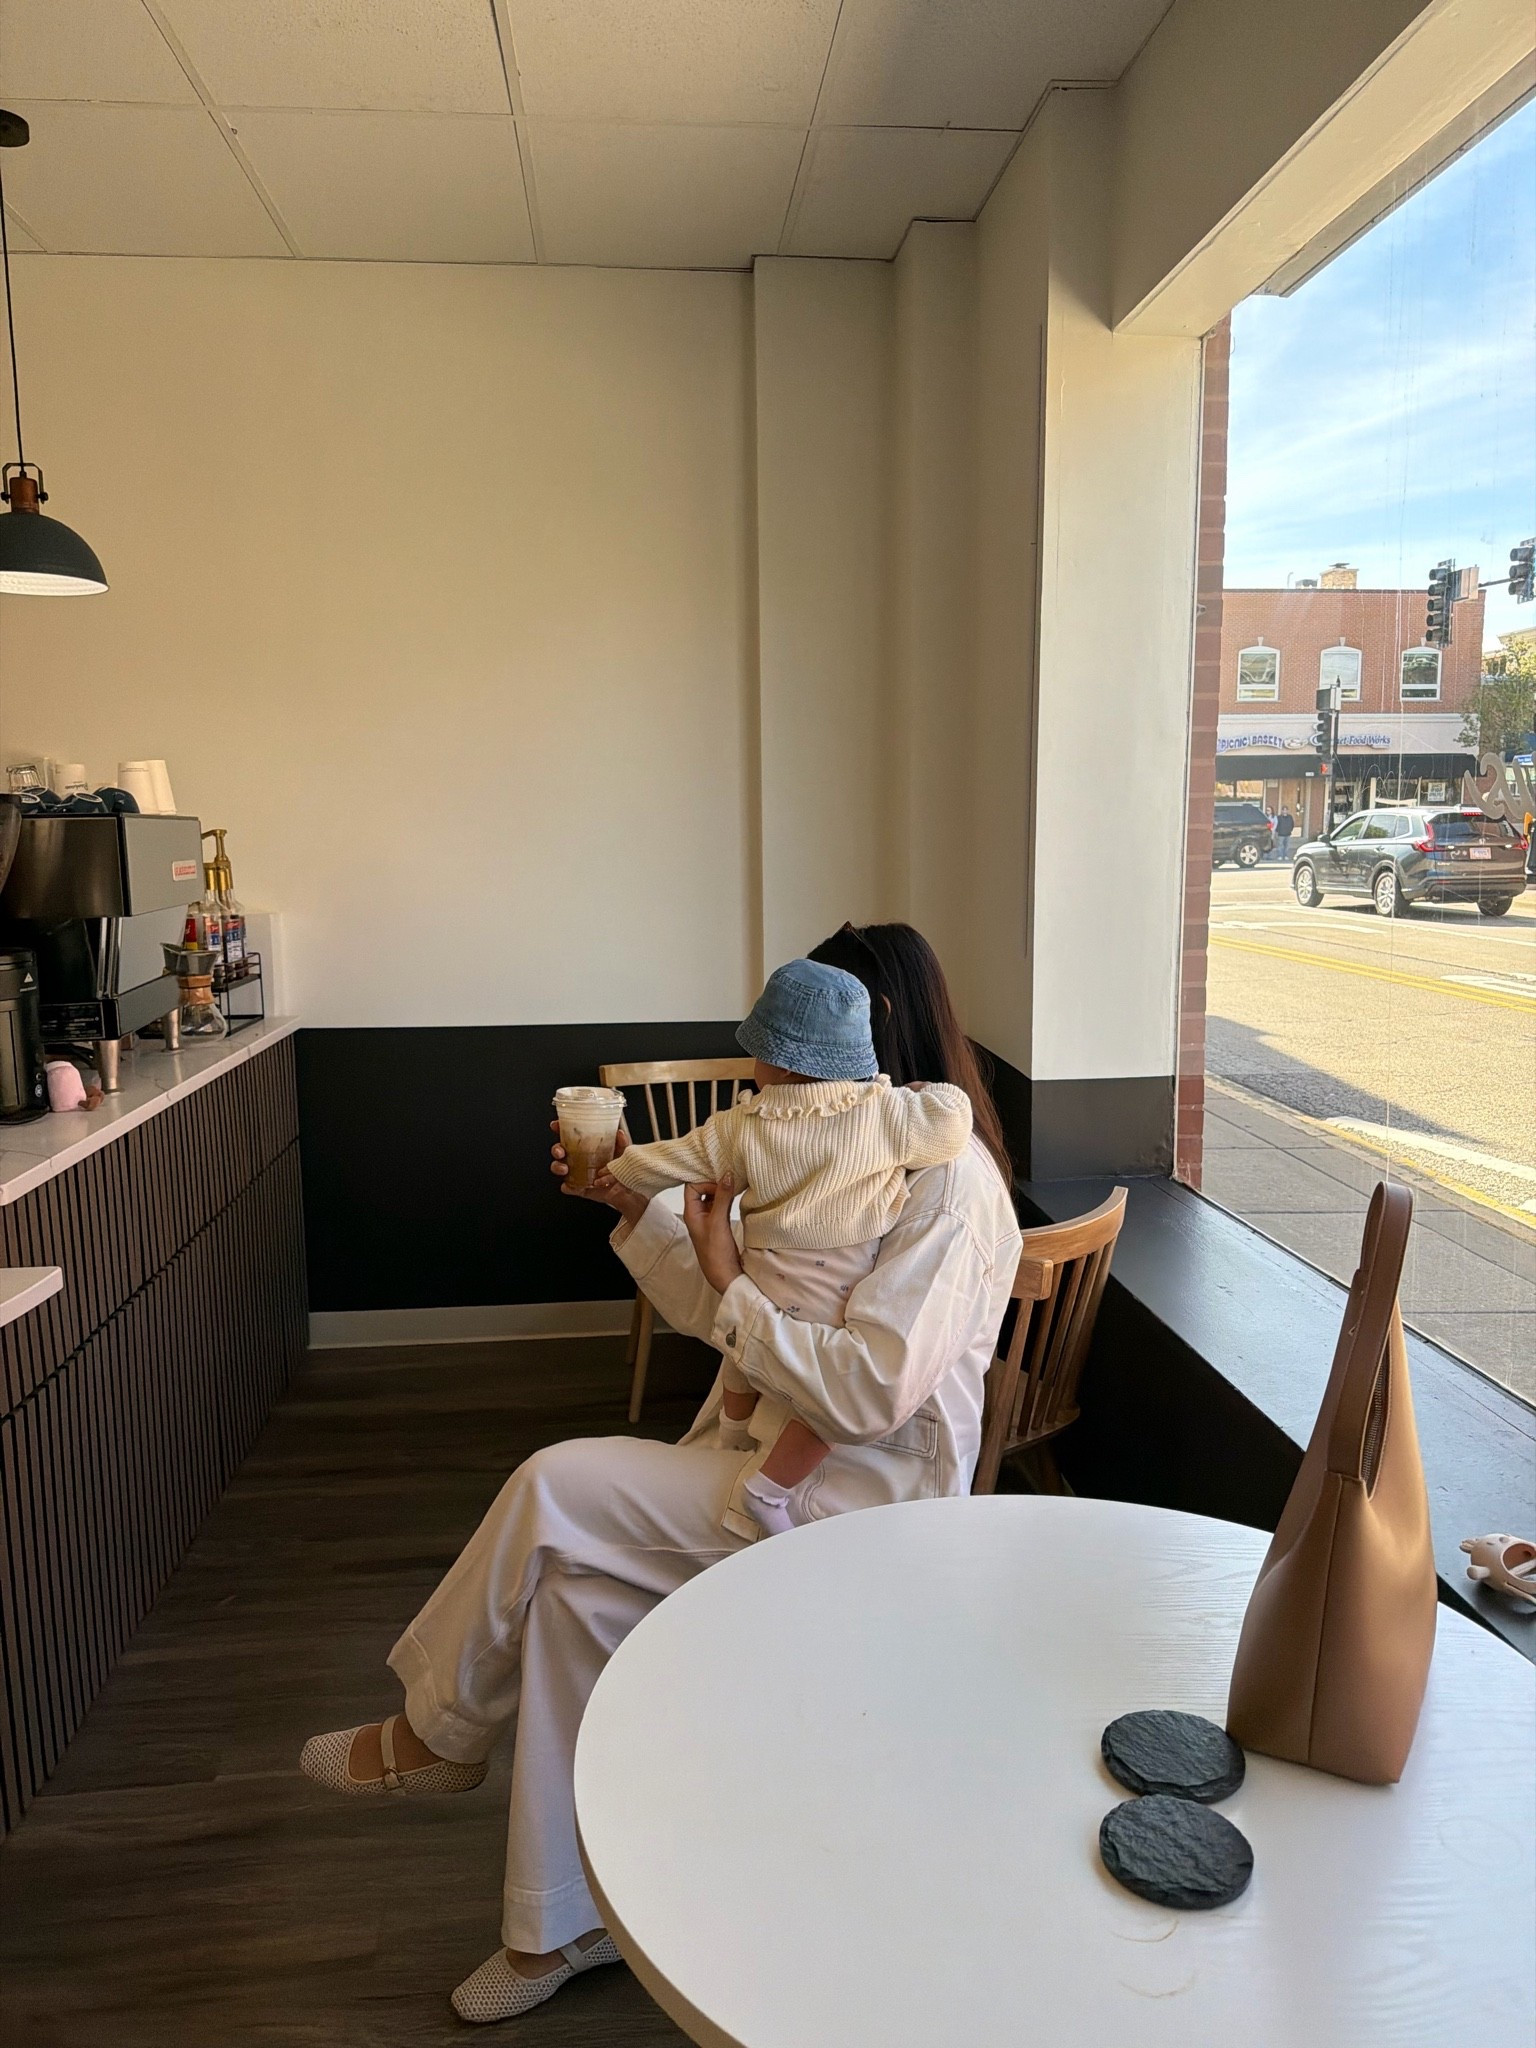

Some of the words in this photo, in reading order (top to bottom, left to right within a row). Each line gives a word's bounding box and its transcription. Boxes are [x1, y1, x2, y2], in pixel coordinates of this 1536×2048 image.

[1252, 735, 1283, 749] BASKET
[1349, 735, 1366, 745] Food
[1368, 734, 1391, 745] Works
